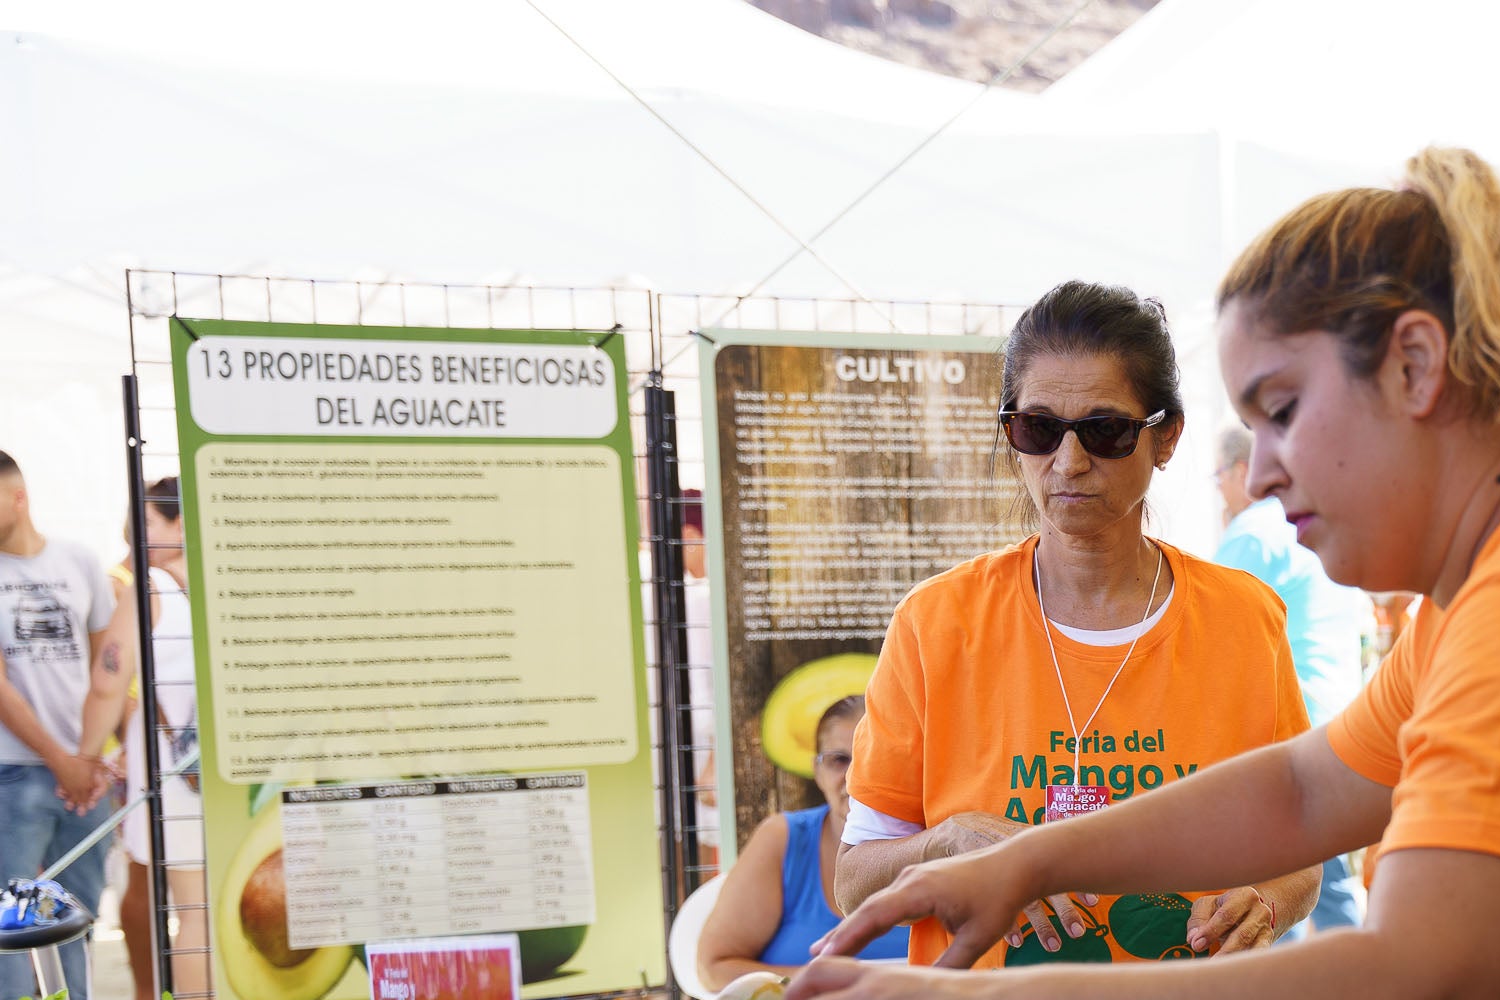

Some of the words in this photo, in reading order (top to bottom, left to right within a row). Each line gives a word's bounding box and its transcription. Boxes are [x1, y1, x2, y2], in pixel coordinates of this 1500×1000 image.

[200, 349, 232, 380] 13
[244, 350, 422, 383] PROPIEDADES
[432, 355, 606, 387] BENEFICIOSAS
[835, 355, 966, 385] CULTIVO
[315, 396, 364, 426] DEL
[371, 398, 507, 428] AGUACATE
[1050, 730, 1116, 753] Feria
[1124, 729, 1164, 752] del
[1010, 754, 1164, 800] Mango
[1099, 794, 1106, 804] y
